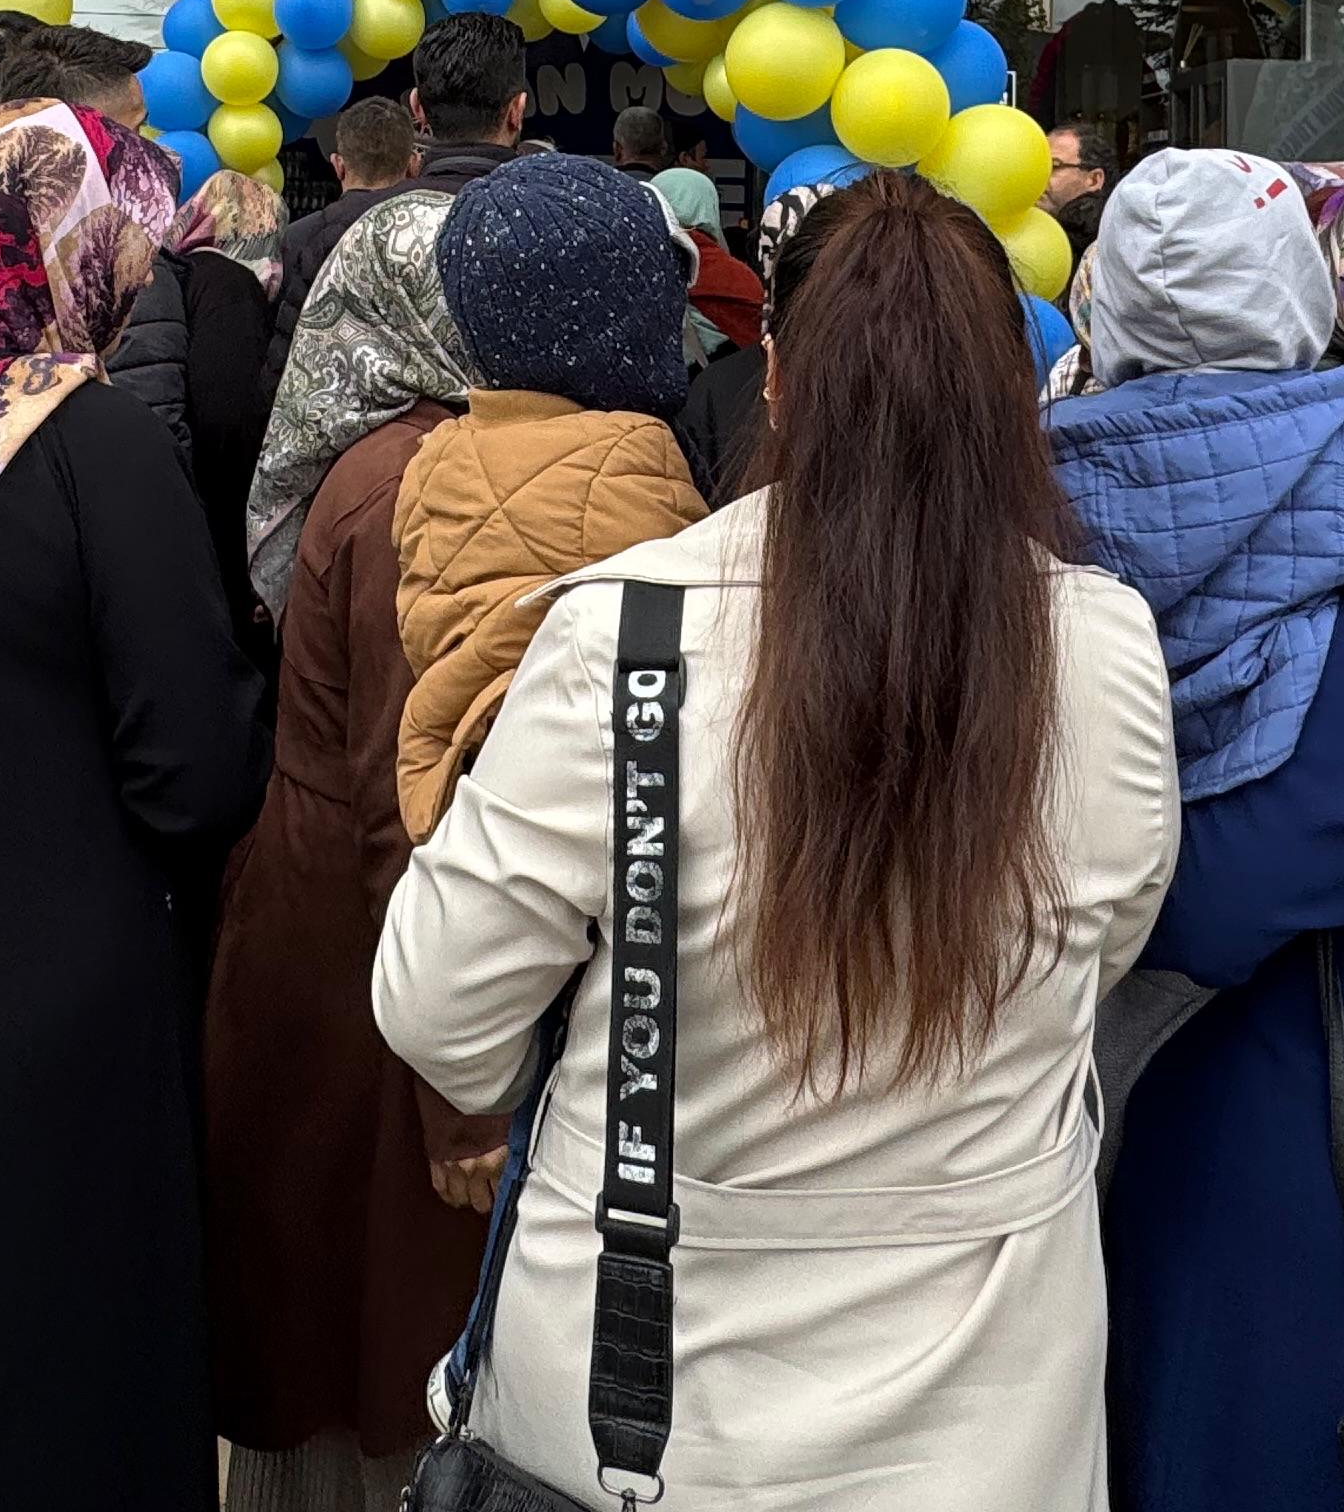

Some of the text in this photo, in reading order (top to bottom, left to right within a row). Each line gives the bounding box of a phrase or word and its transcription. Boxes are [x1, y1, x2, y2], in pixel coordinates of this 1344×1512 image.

[625, 759, 666, 945] DON'T
[619, 966, 662, 1102] YOU
[617, 1119, 656, 1185] IF
